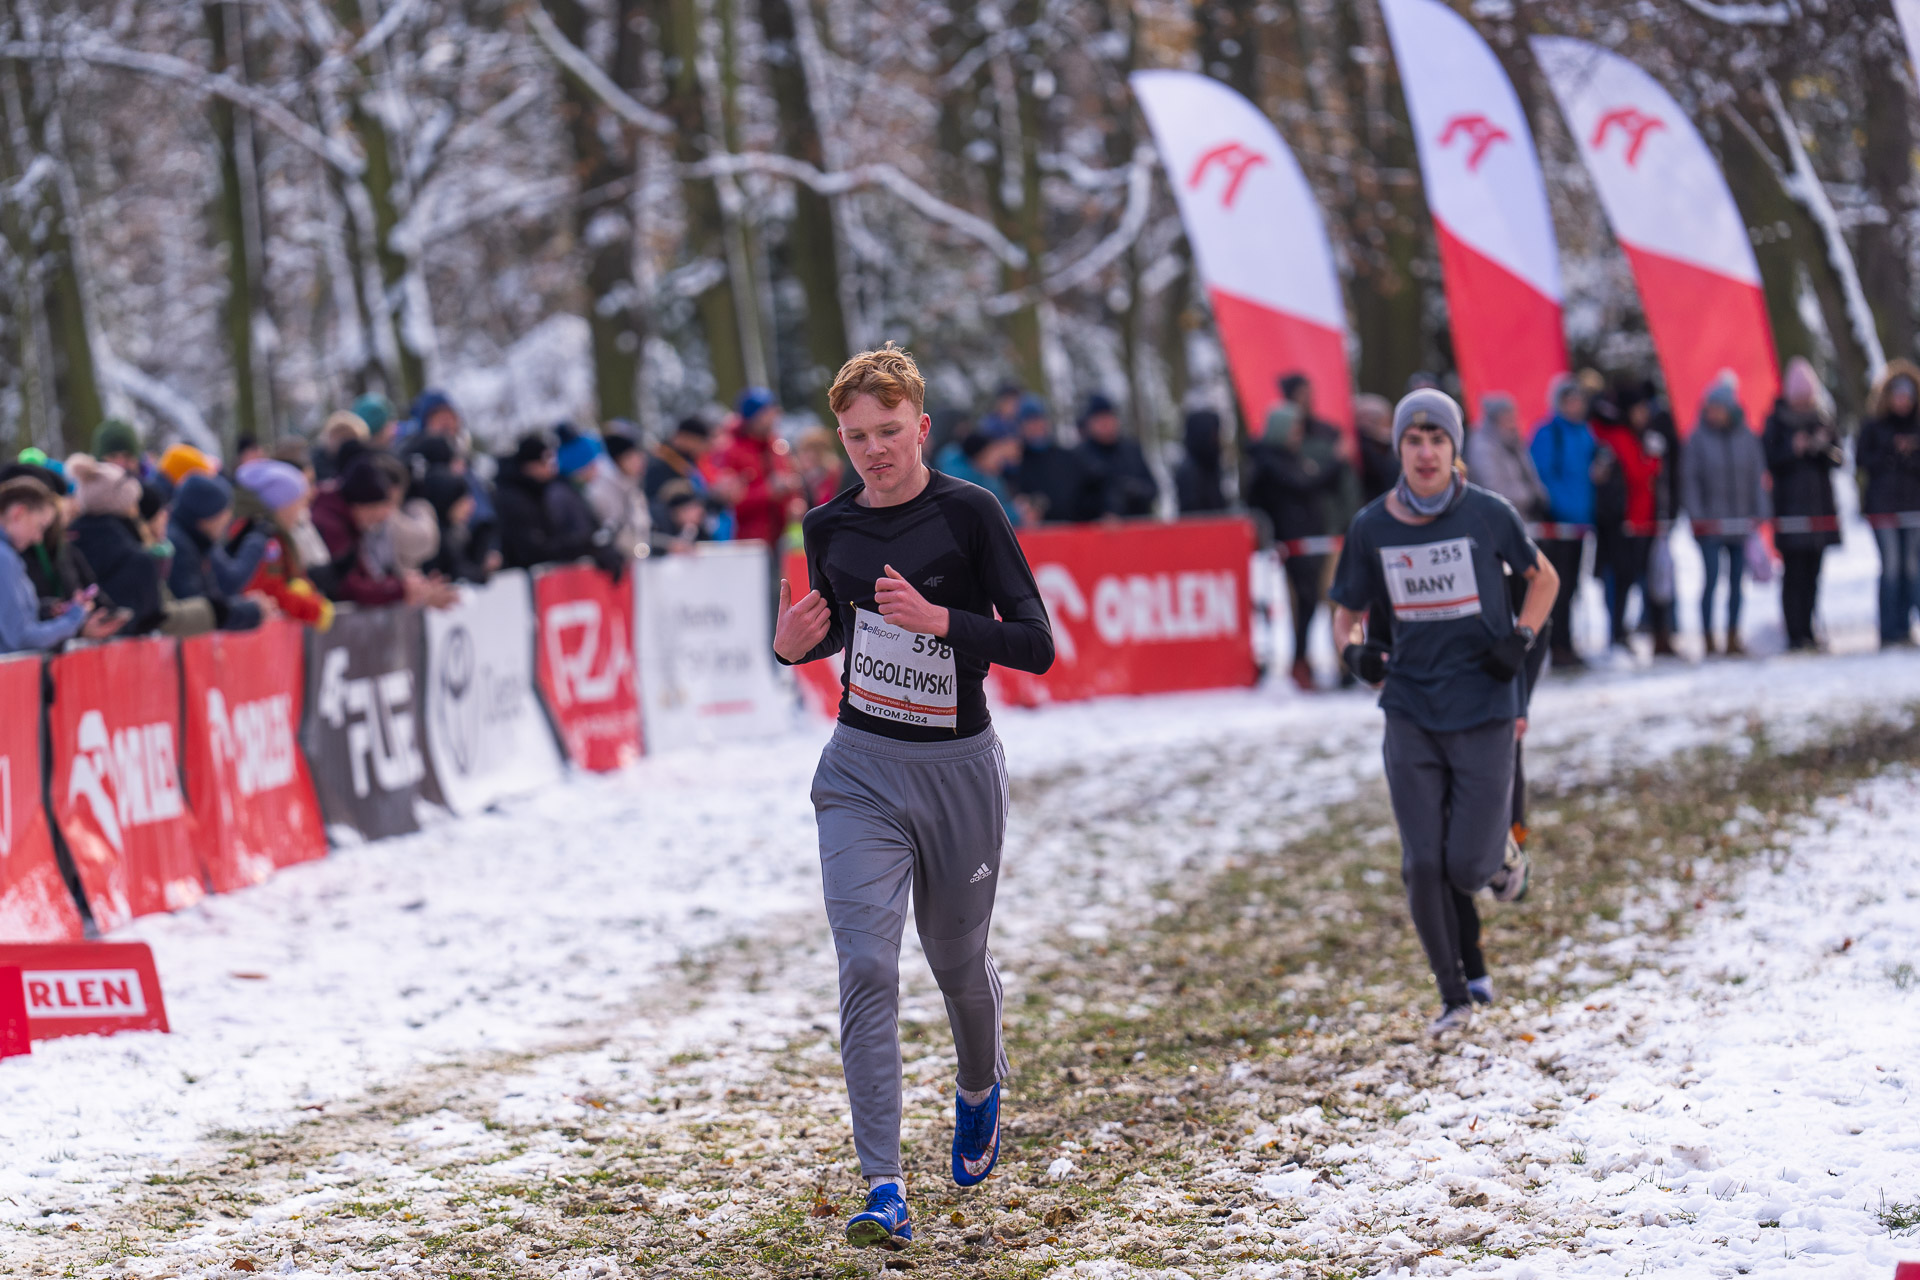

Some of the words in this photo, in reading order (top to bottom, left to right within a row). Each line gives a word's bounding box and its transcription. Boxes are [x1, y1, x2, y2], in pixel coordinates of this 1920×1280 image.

[1429, 544, 1462, 565] 255
[923, 575, 945, 588] 4F
[1405, 573, 1456, 595] BANY
[1092, 568, 1240, 647] ORLEN
[912, 634, 952, 660] 598
[854, 652, 953, 696] GOGOLEWSKI
[865, 703, 900, 720] BYTOM
[902, 712, 928, 724] 2024
[28, 979, 132, 1008] RLEN
